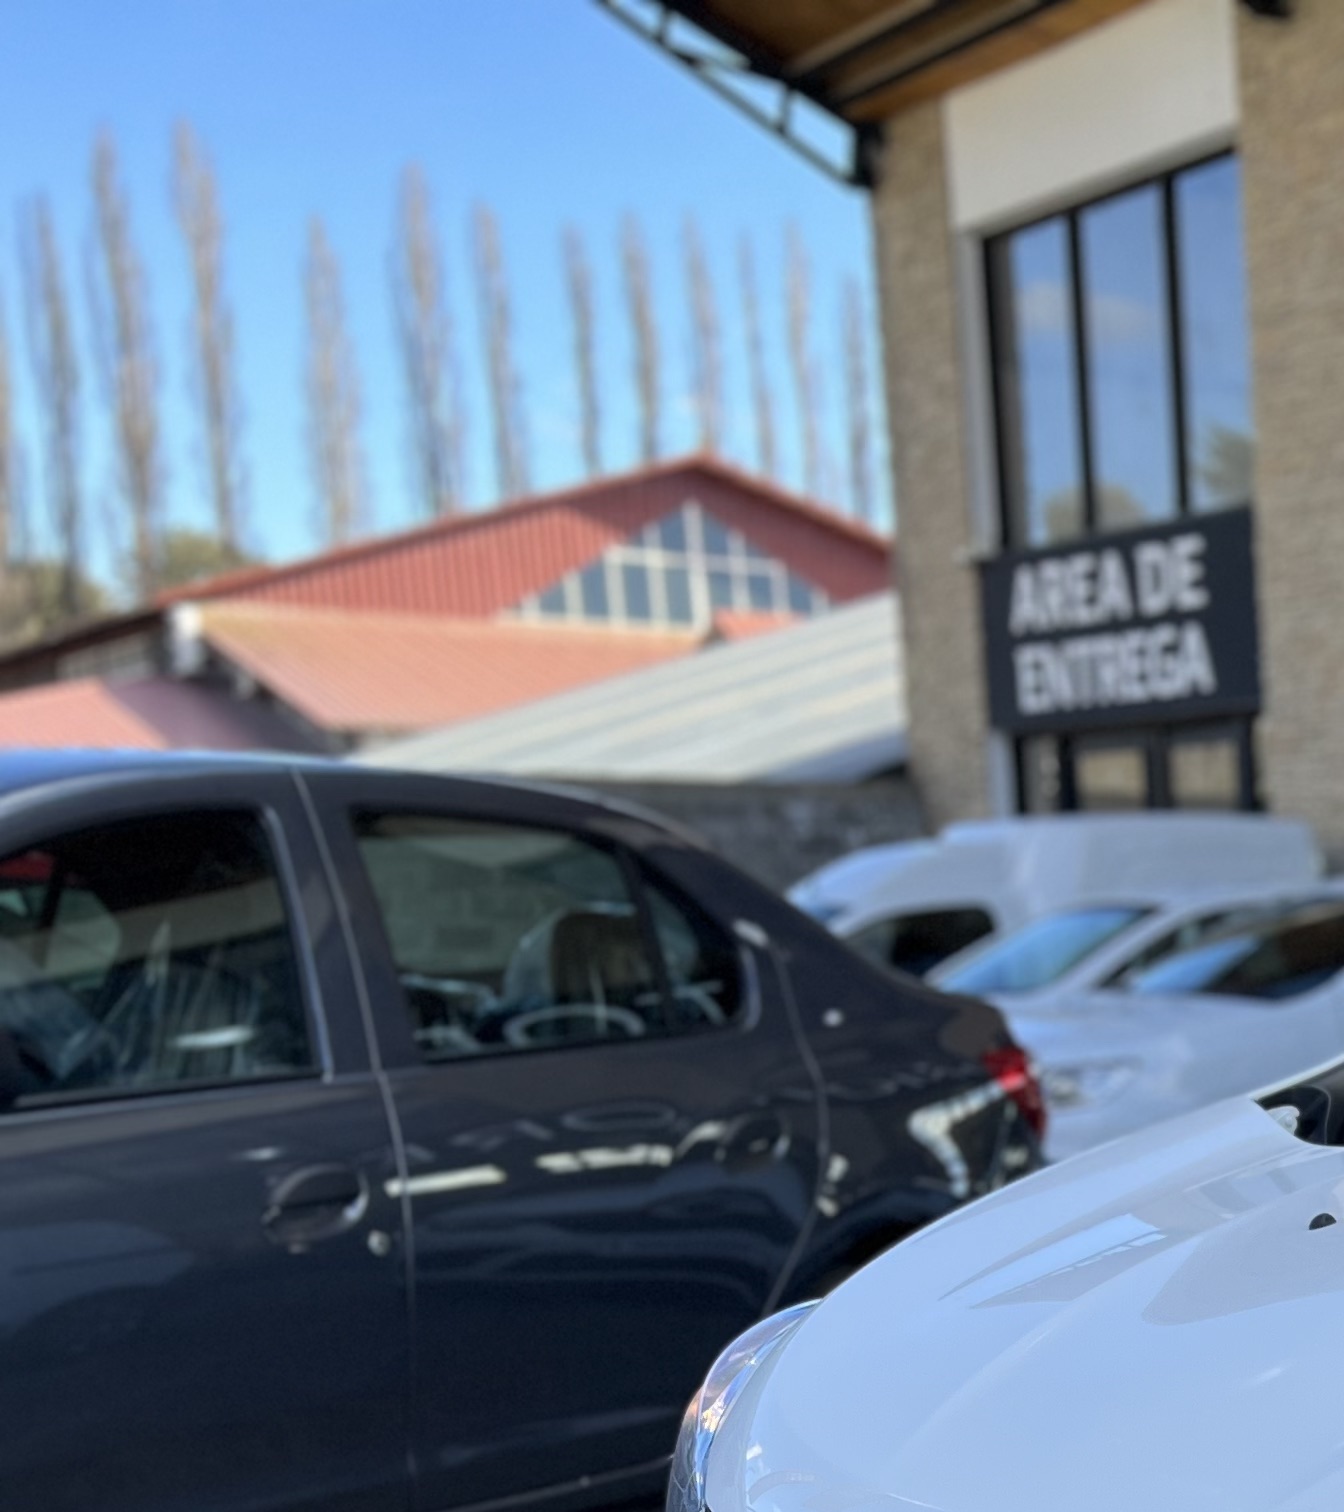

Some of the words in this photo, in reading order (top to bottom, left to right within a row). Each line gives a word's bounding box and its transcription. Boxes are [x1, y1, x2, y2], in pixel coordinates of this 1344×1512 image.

[1009, 546, 1134, 637] AREA
[1134, 533, 1210, 617] DE
[1012, 619, 1217, 715] ENTREGA
